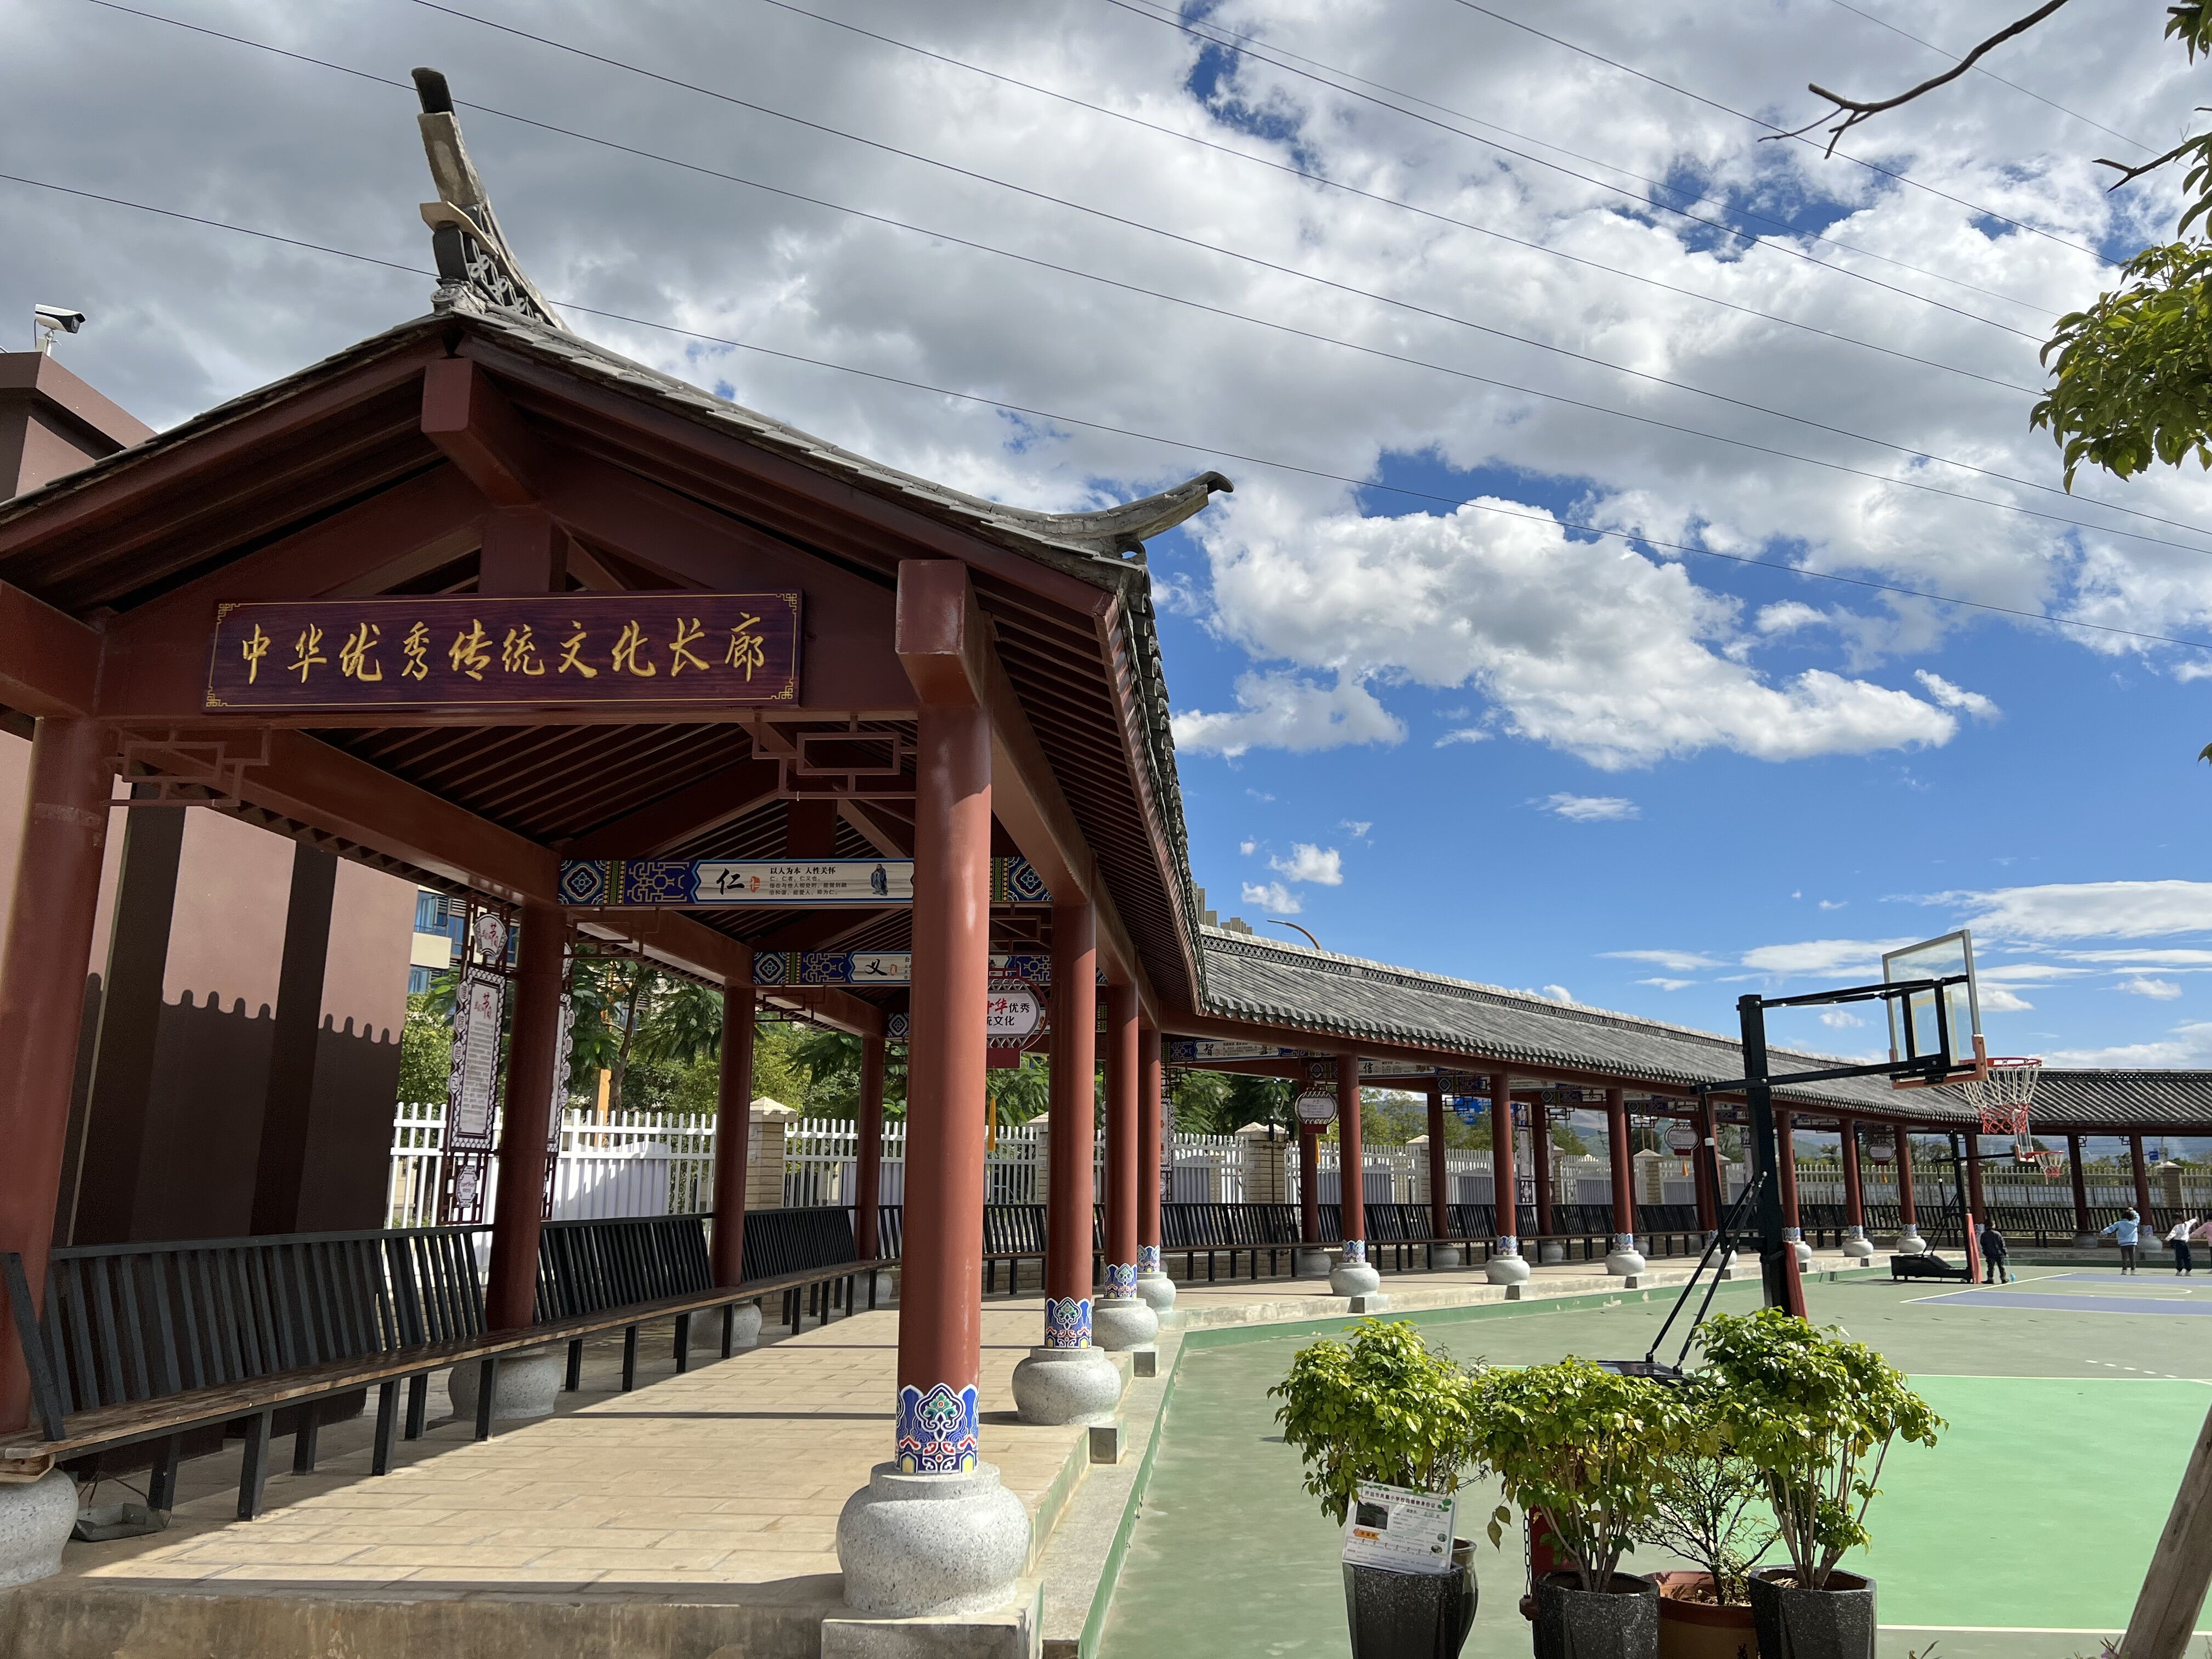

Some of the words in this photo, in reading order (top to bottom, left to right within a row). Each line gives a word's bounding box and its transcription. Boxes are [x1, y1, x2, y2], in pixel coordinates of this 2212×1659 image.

[242, 612, 766, 684] 中华优秀传统文化长廊
[805, 866, 836, 874] 人性关怀
[716, 868, 745, 895] 仁
[864, 958, 888, 975] 义
[1204, 1043, 1214, 1057] 智
[1363, 1062, 1373, 1074] 信
